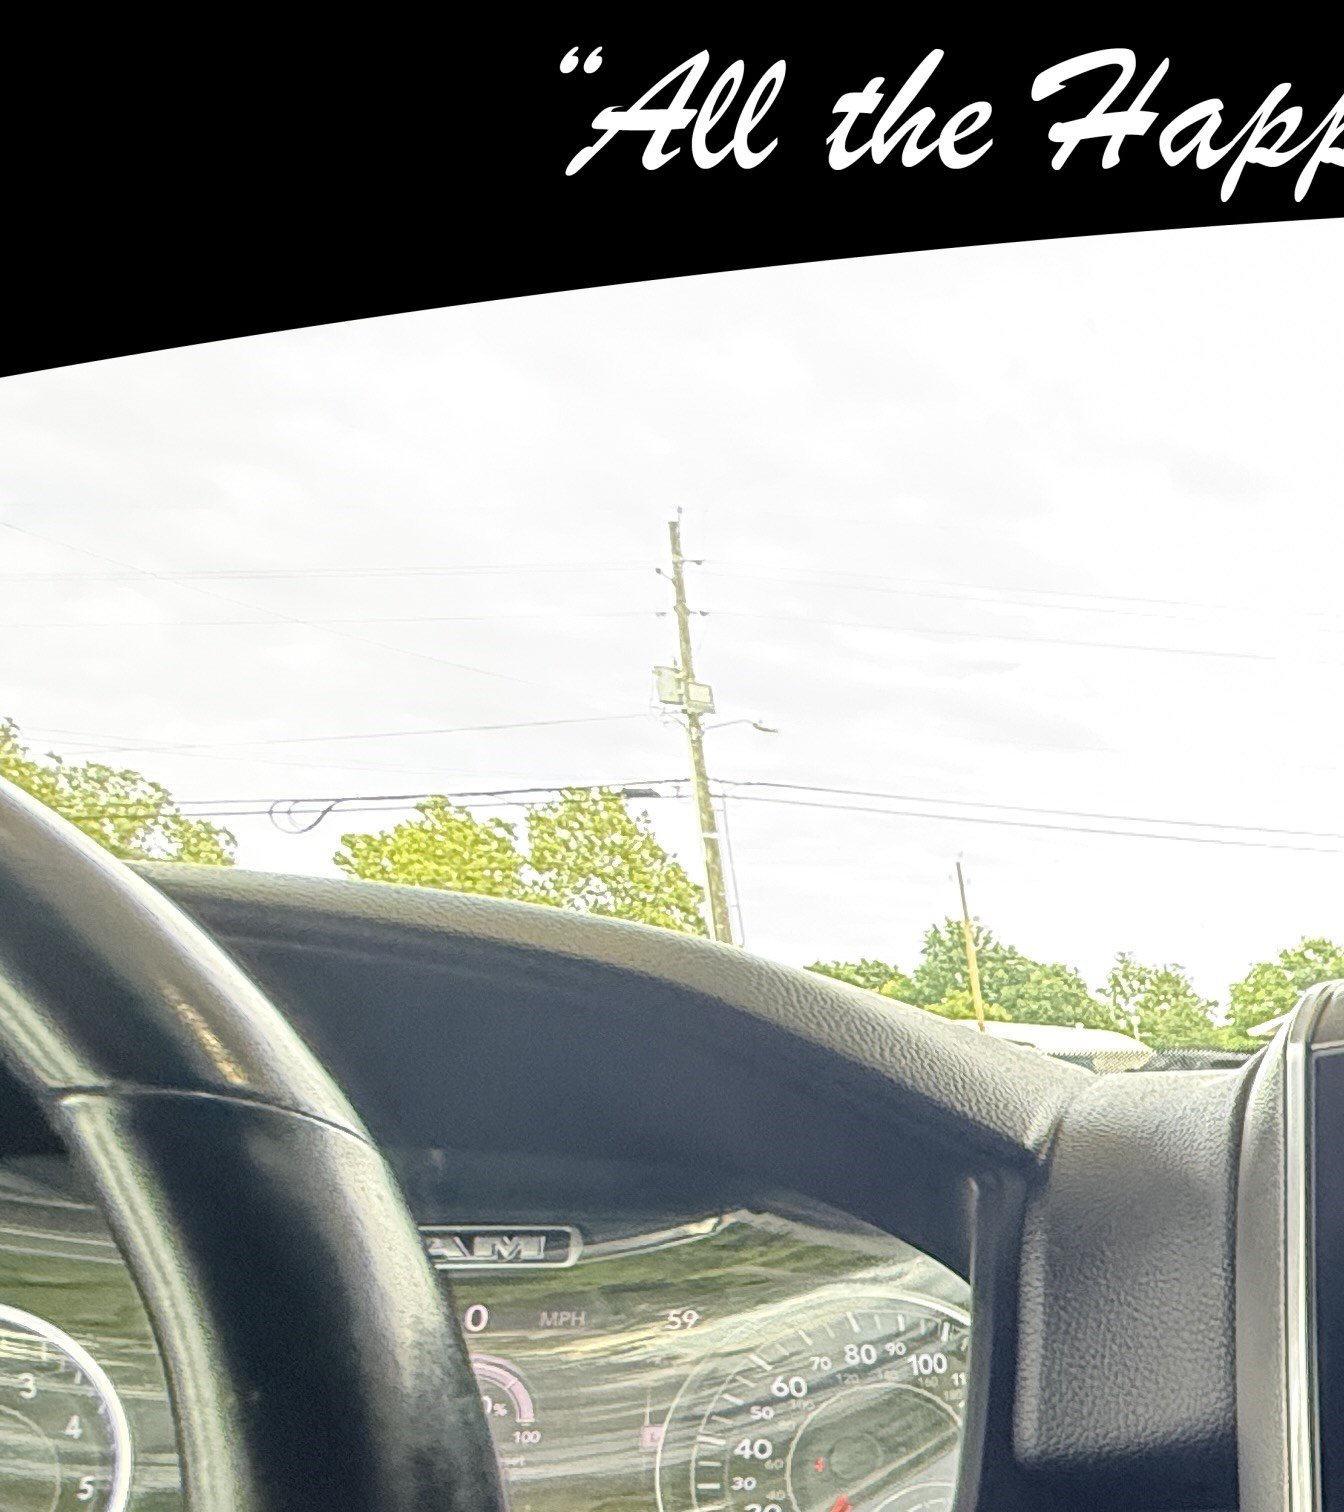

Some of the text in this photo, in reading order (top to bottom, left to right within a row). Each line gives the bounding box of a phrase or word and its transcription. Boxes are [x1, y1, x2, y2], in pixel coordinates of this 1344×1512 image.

[425, 1235, 546, 1259] AM
[538, 1311, 587, 1326] MPH
[844, 1344, 876, 1364] 80
[884, 1342, 906, 1355] 90
[810, 1357, 831, 1370] 70
[908, 1353, 947, 1375] 100
[18, 1373, 37, 1399] 3
[771, 1376, 807, 1397] 60
[750, 1407, 774, 1420] 50
[64, 1415, 82, 1439] 4
[734, 1439, 772, 1459] 40
[76, 1476, 95, 1500] 5
[731, 1477, 756, 1490] 30
